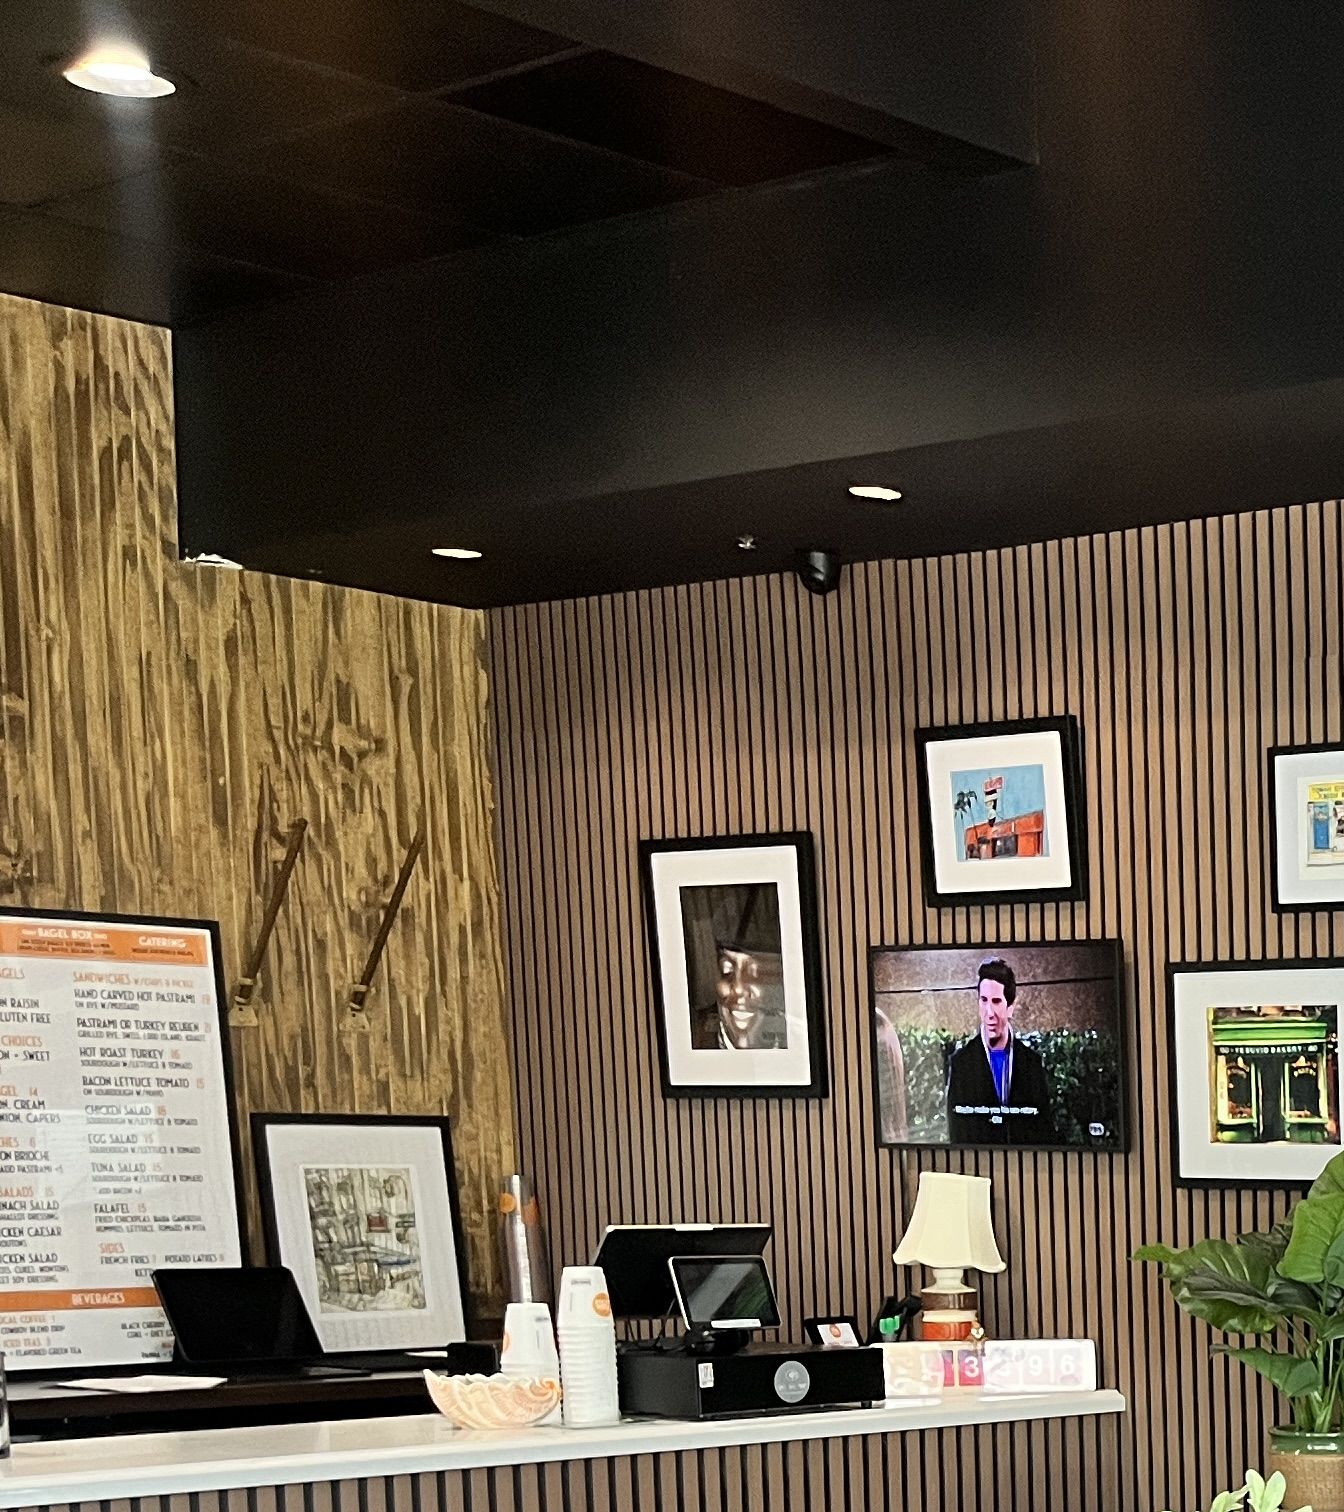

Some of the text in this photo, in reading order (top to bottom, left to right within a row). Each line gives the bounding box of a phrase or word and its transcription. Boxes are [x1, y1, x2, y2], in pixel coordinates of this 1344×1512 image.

[74, 989, 196, 1004] HAND CARVED HOT PASTRAMI
[10, 998, 39, 1008] RAISIN
[30, 1013, 51, 1023] FREE
[76, 1017, 199, 1032] PASTRAMI OR TURKEY REUBEN
[1, 1035, 43, 1047] CHOICES
[22, 1050, 50, 1061] SWEET
[80, 1047, 96, 1057] HOT
[100, 1047, 127, 1058] ROAST
[130, 1048, 165, 1059] TURKEY
[82, 1076, 112, 1086] BACON
[114, 1077, 152, 1088] LETTUCE
[155, 1077, 190, 1088] TOMATO
[13, 1099, 46, 1110] CREAM
[124, 1104, 152, 1116] SALAD
[26, 1112, 61, 1123] CAPERS
[109, 1133, 138, 1144] SALAD
[15, 1151, 49, 1161] BRIOCHE
[91, 1162, 114, 1173] TUNA
[118, 1162, 147, 1173] SALAD
[31, 1200, 59, 1210] SALAD
[94, 1203, 129, 1214] FALAFEL
[27, 1227, 62, 1237] CAESAR
[99, 1243, 125, 1254] SIDES
[28, 1253, 58, 1263] SALAD
[71, 1292, 125, 1305] BEVERAGES
